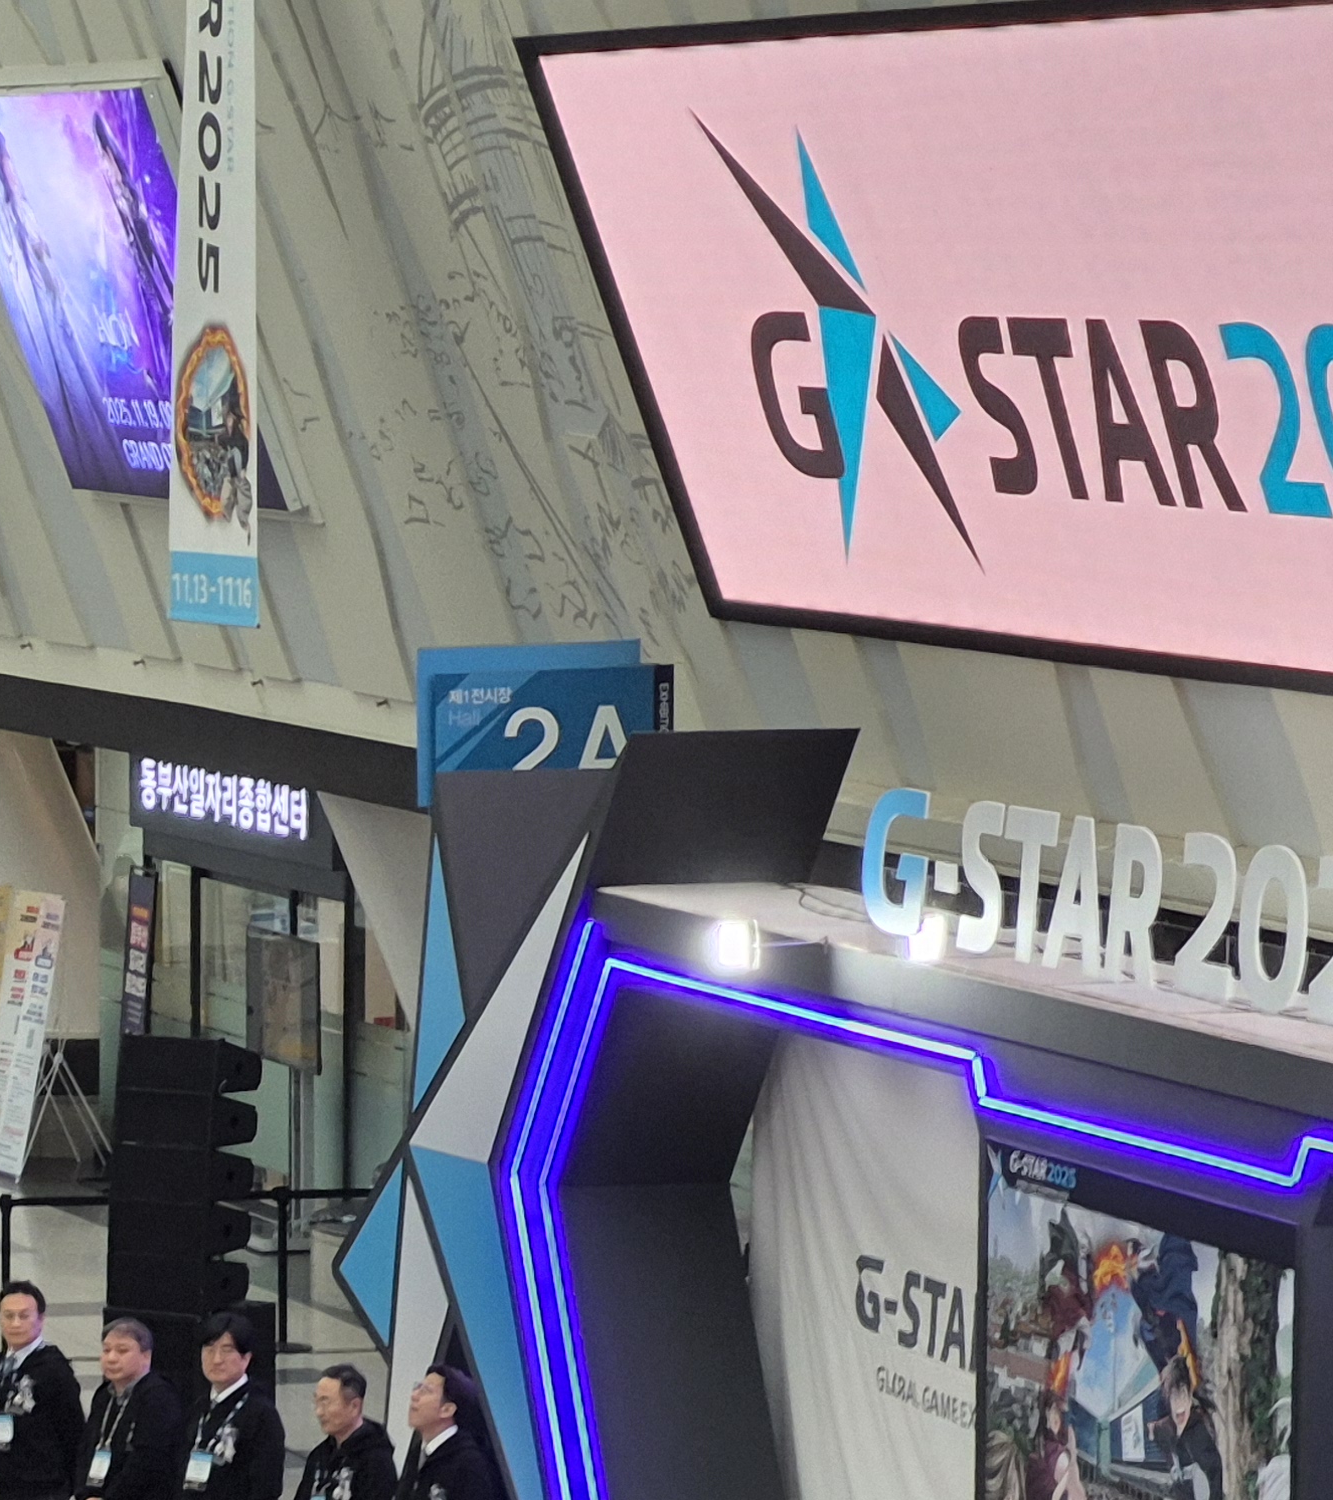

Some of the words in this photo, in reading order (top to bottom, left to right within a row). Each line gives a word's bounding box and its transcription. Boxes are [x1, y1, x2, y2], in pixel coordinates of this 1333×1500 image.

[198, 50, 222, 293] 2025
[449, 686, 513, 704] 제1전시장
[139, 757, 309, 841] 동부산일자리종합센터
[862, 787, 1163, 989] G-STAR
[855, 1254, 977, 1374] G-STA
